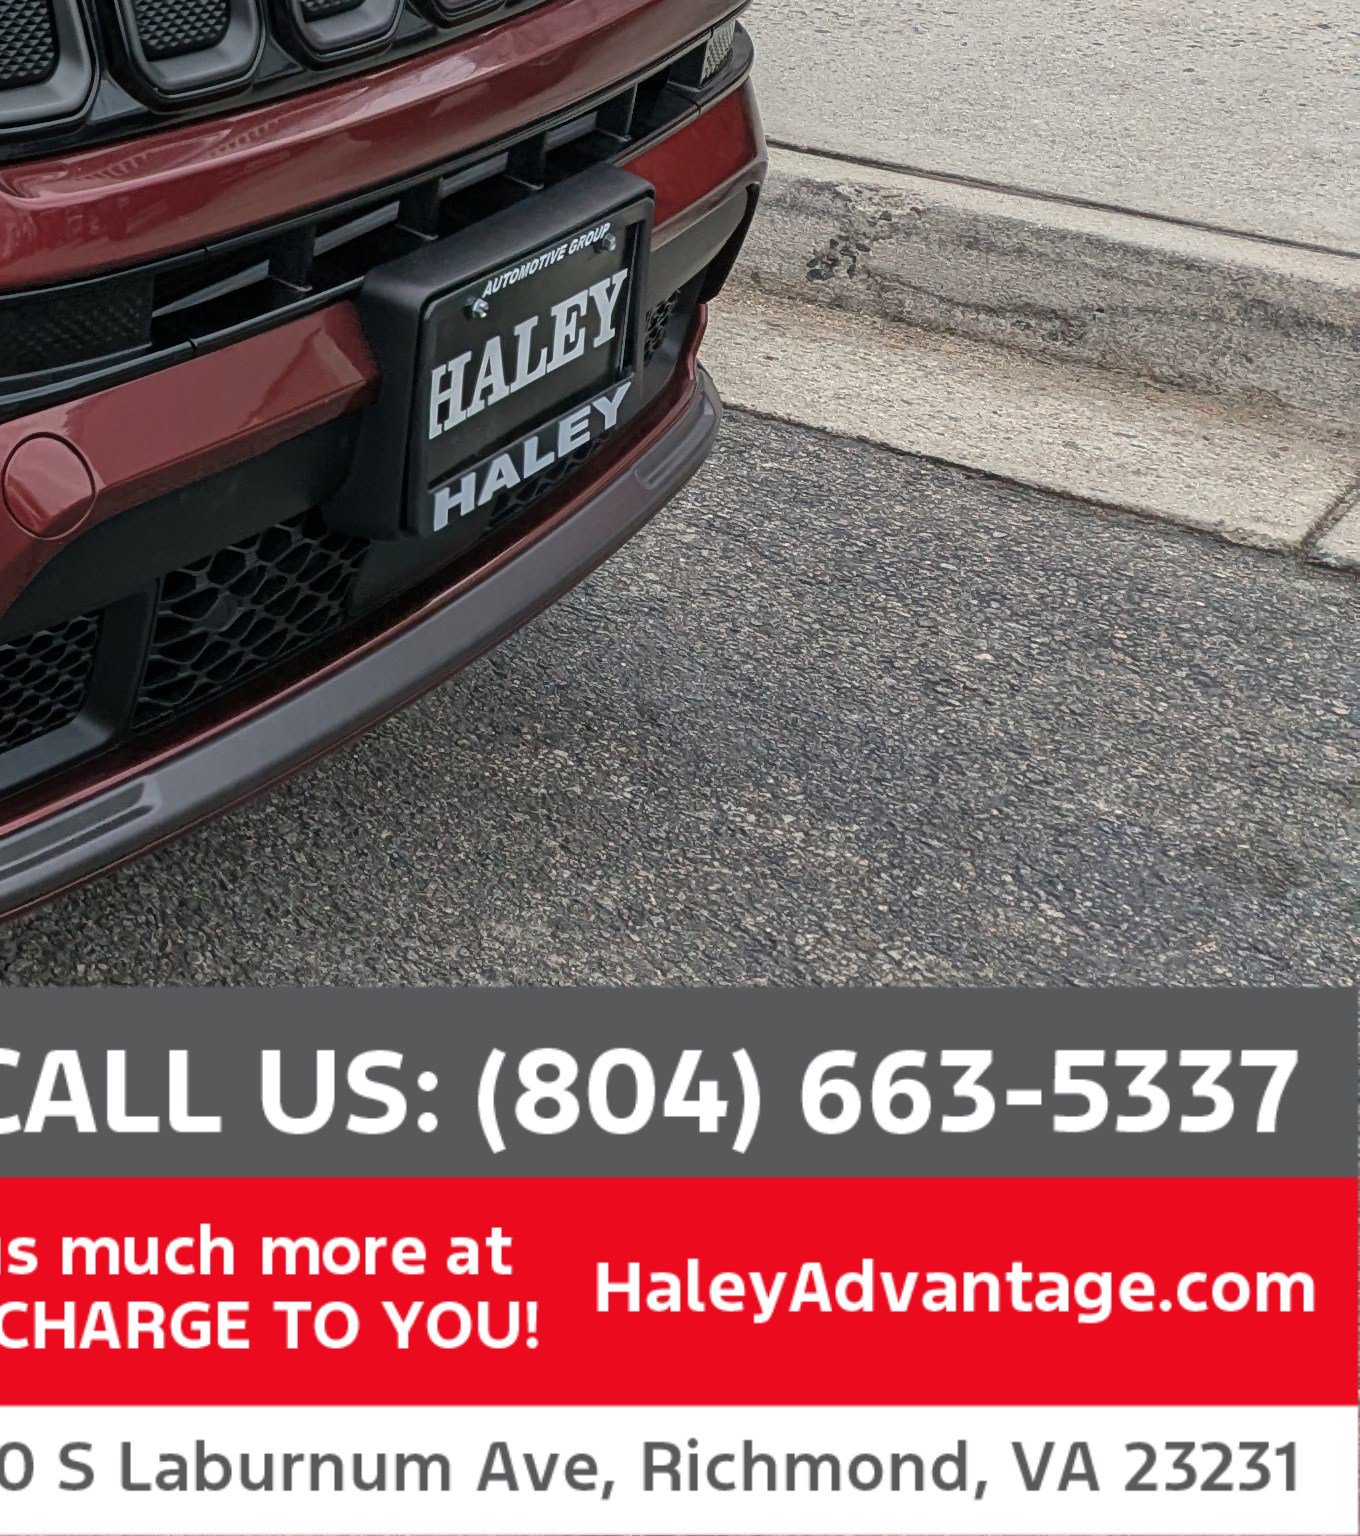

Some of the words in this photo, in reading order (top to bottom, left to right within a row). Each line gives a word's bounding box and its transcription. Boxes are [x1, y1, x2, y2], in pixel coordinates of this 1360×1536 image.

[481, 242, 568, 299] AUTOMOTIVE
[568, 222, 612, 257] GROUP
[428, 268, 628, 440] HALEY
[433, 381, 632, 533] HALEY
